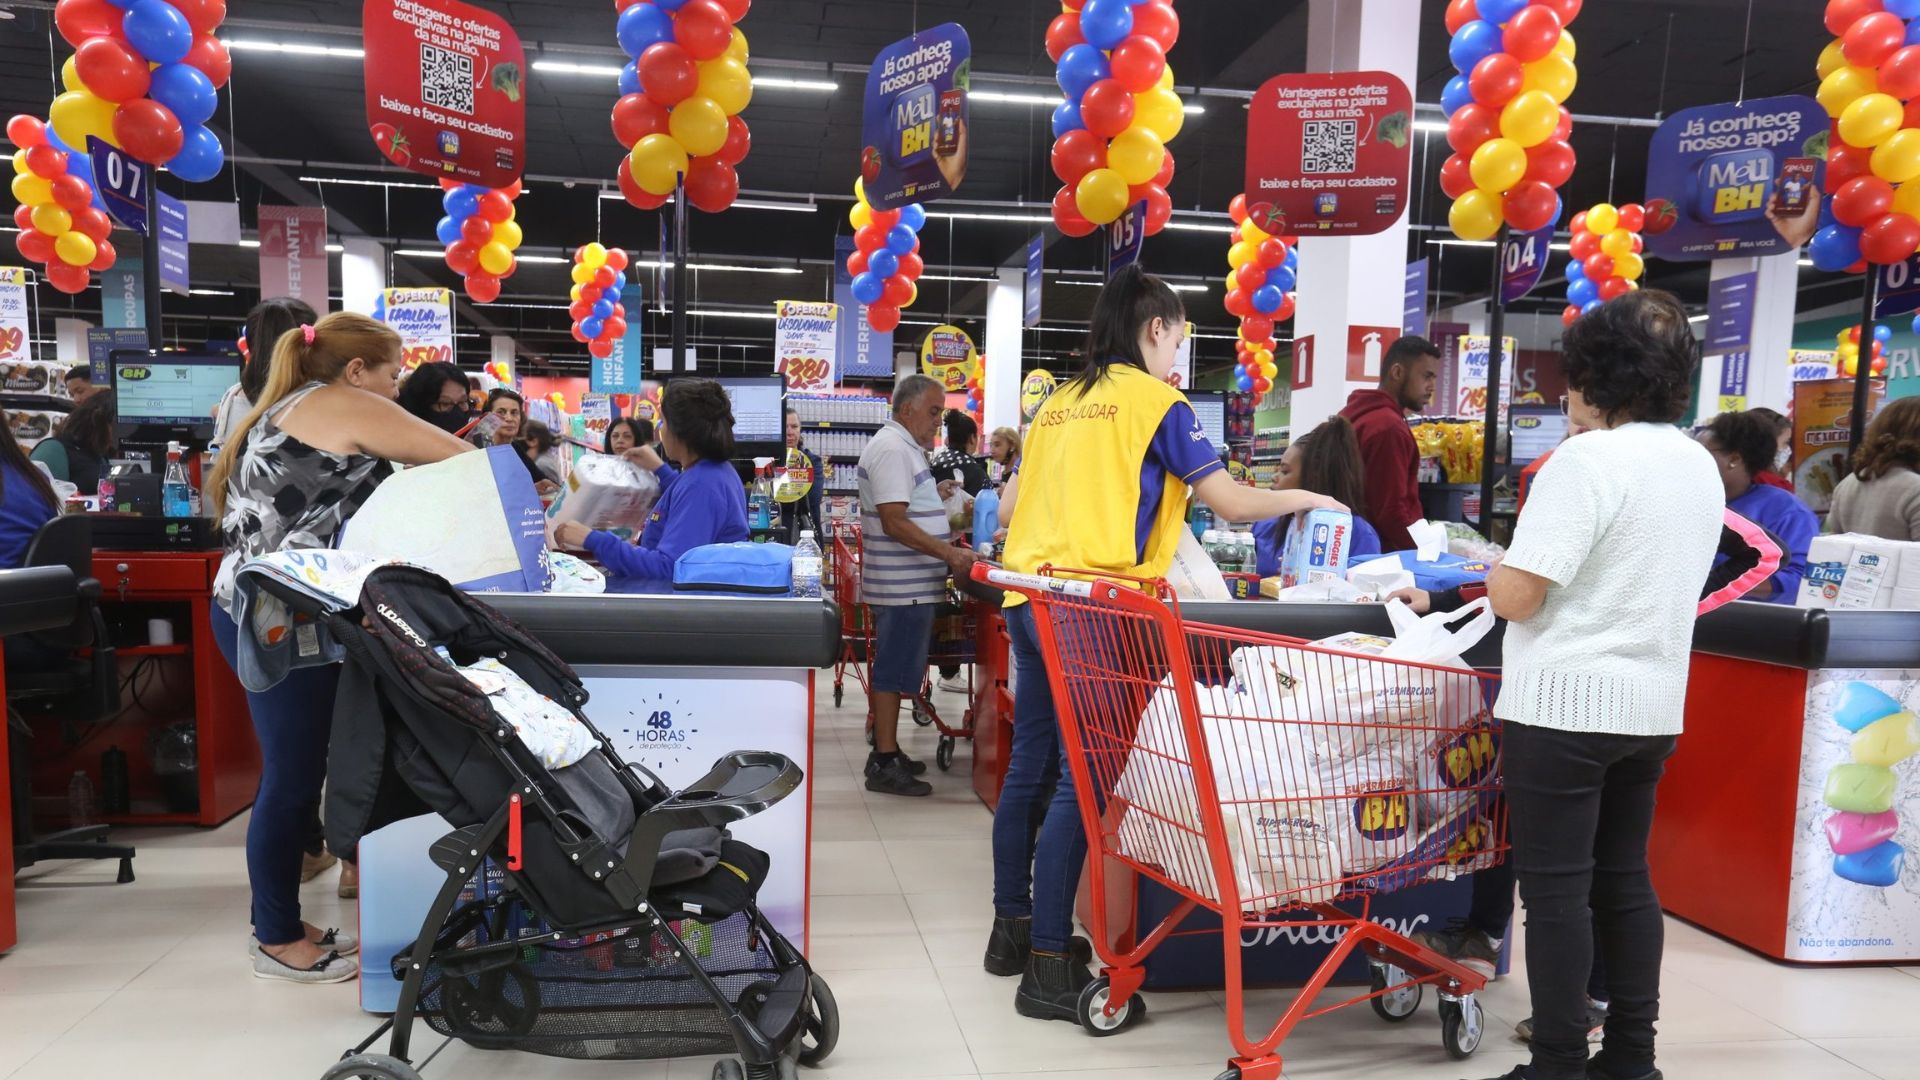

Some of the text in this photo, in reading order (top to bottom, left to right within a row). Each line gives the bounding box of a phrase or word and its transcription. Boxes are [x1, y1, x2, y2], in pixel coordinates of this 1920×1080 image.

[393, 9, 500, 51] exclusivas na palma
[454, 18, 461, 26] e
[463, 20, 501, 39] ofertas
[415, 27, 480, 57] da sua mão.
[880, 40, 953, 79] Já conhece
[880, 54, 952, 96] nosso app?
[1278, 84, 1388, 100] Vantagens e ofertas
[1278, 96, 1387, 109] exclusivas na palma
[380, 95, 513, 141] baixe e faça seu cadastro
[1298, 107, 1365, 119] da sua mão.
[1679, 111, 1801, 138] Já conhece
[901, 121, 931, 158] BH
[1678, 124, 1801, 153] nosso app?
[107, 151, 141, 199] 07
[1260, 176, 1397, 190] baixe e faça seu cadastro
[1713, 183, 1765, 214] BH
[1113, 212, 1134, 251] 05
[1506, 236, 1536, 274] 04
[1718, 241, 1736, 251] BH
[1756, 238, 1776, 248] VOCÊ
[393, 290, 440, 304] OFERTA
[787, 303, 829, 317] OFERTA
[122, 369, 146, 379] BH
[602, 352, 613, 386] HIGI
[1329, 525, 1345, 568] HUGGIES
[1860, 555, 1879, 566] Plus
[1811, 566, 1843, 581] Plus
[1236, 579, 1247, 598] BH
[377, 603, 427, 648] Galzerano
[647, 710, 672, 730] 48
[636, 730, 685, 742] HORAS
[640, 742, 682, 750] de proteção
[1361, 793, 1406, 831] BH
[1799, 937, 1895, 947] Não te abandona.
